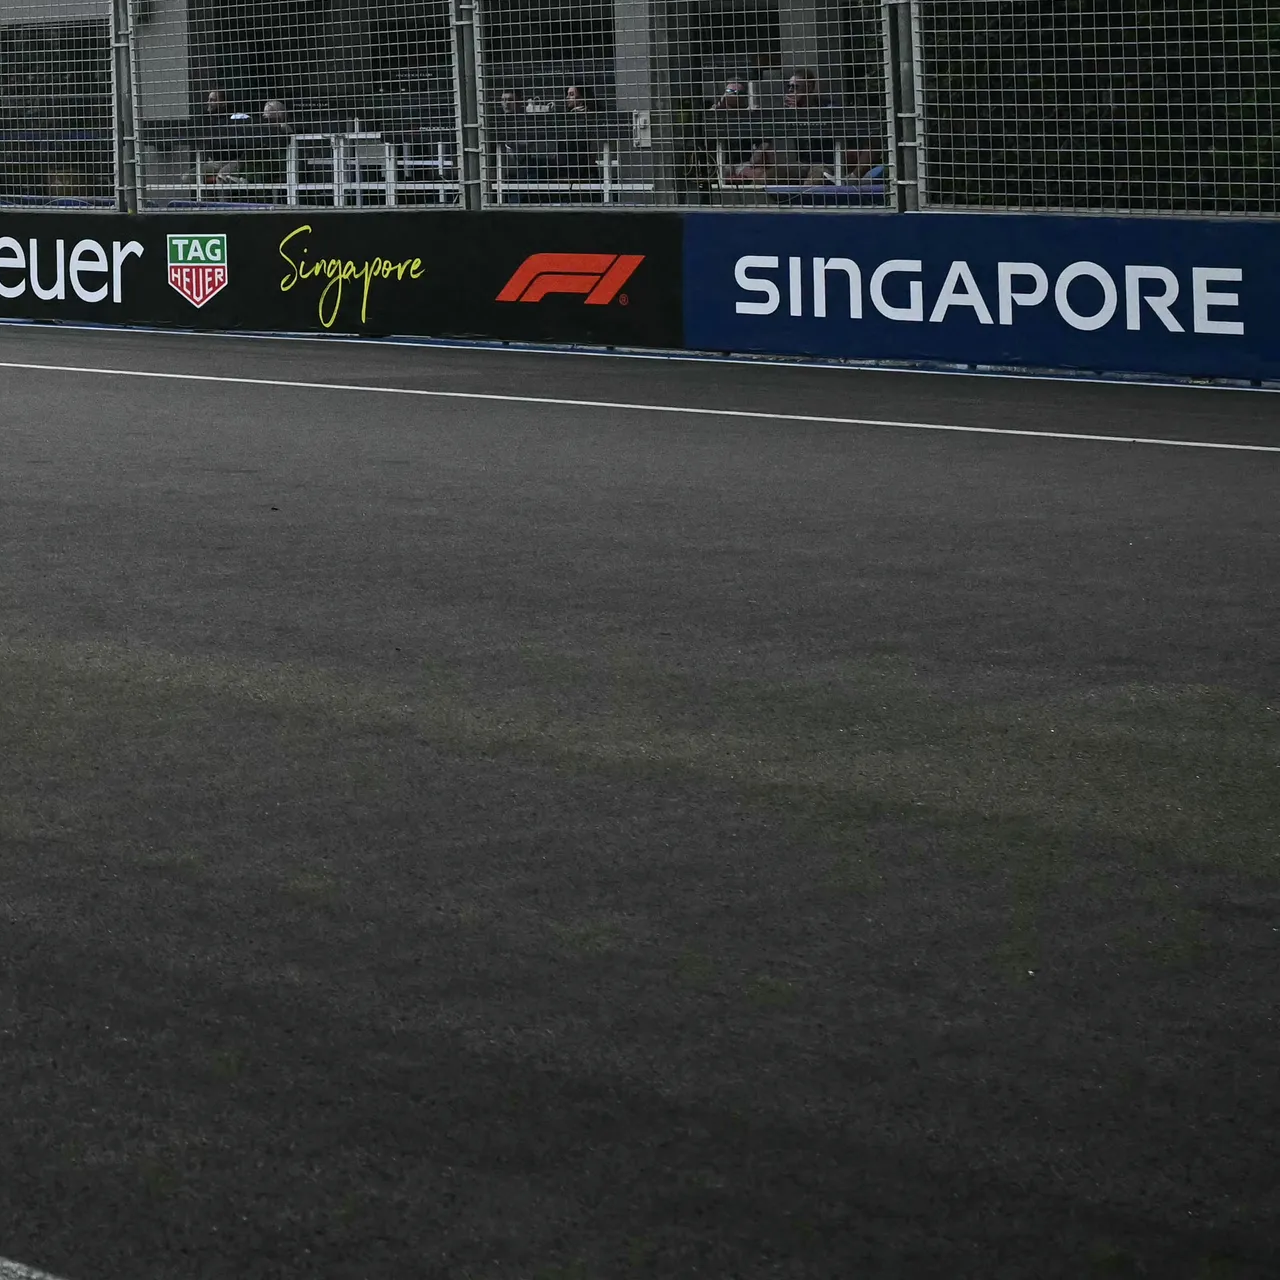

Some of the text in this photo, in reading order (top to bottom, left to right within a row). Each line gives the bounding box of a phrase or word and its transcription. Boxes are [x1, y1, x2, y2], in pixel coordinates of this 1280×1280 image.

[172, 238, 223, 262] TAG
[277, 224, 426, 329] Singapore
[168, 265, 227, 304] HEUER
[734, 254, 1246, 337] SINGAPORE
